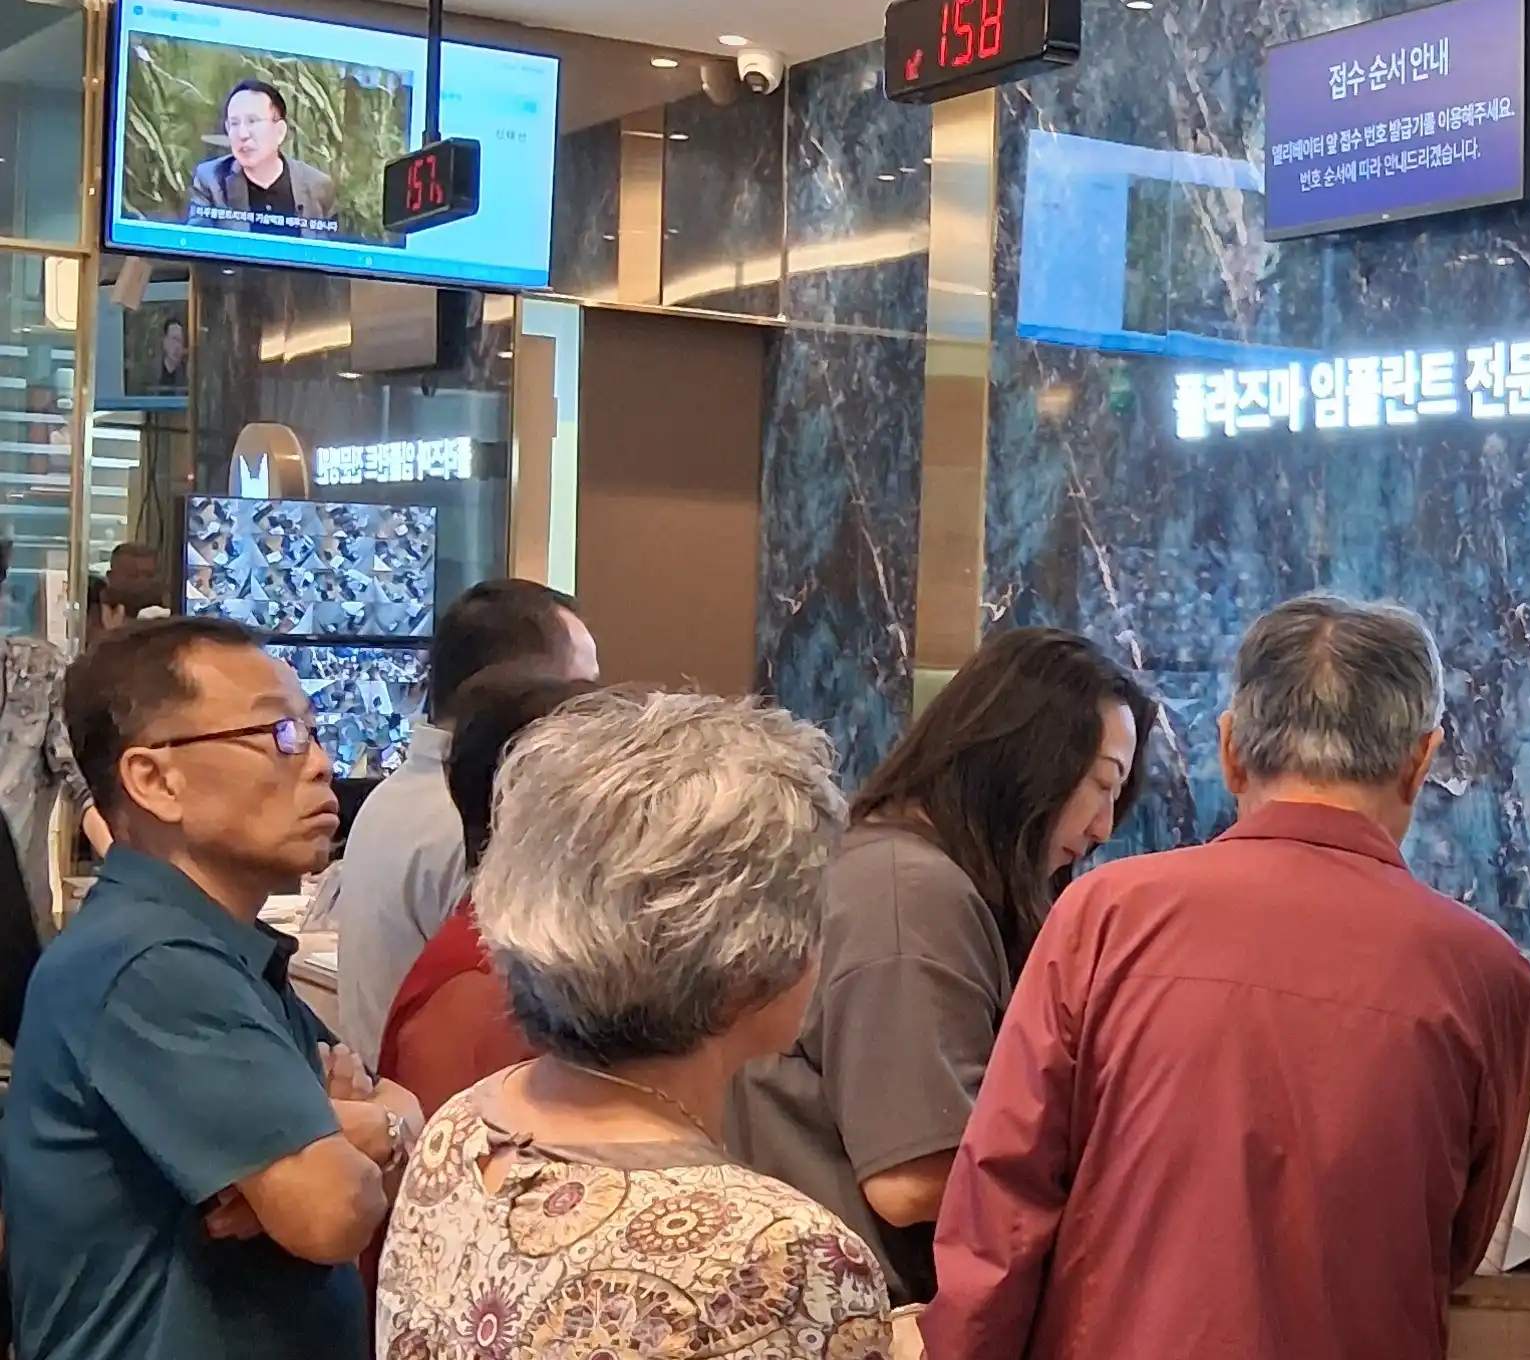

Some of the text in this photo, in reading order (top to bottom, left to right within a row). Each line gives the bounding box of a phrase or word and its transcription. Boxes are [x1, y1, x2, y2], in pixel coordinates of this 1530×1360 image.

[1328, 36, 1450, 100] 접수 순서 안내
[1325, 131, 1338, 156] 앞
[1340, 128, 1362, 153] 접수
[1364, 123, 1388, 147] 번호
[1389, 111, 1436, 143] 발급기를
[1438, 96, 1515, 132] 이용해주세요.
[1299, 136, 1481, 193] 번호 순서에 따라 안내드리겠습니다.
[1172, 361, 1307, 440] 플라즈마
[1310, 348, 1460, 429] 임플란트
